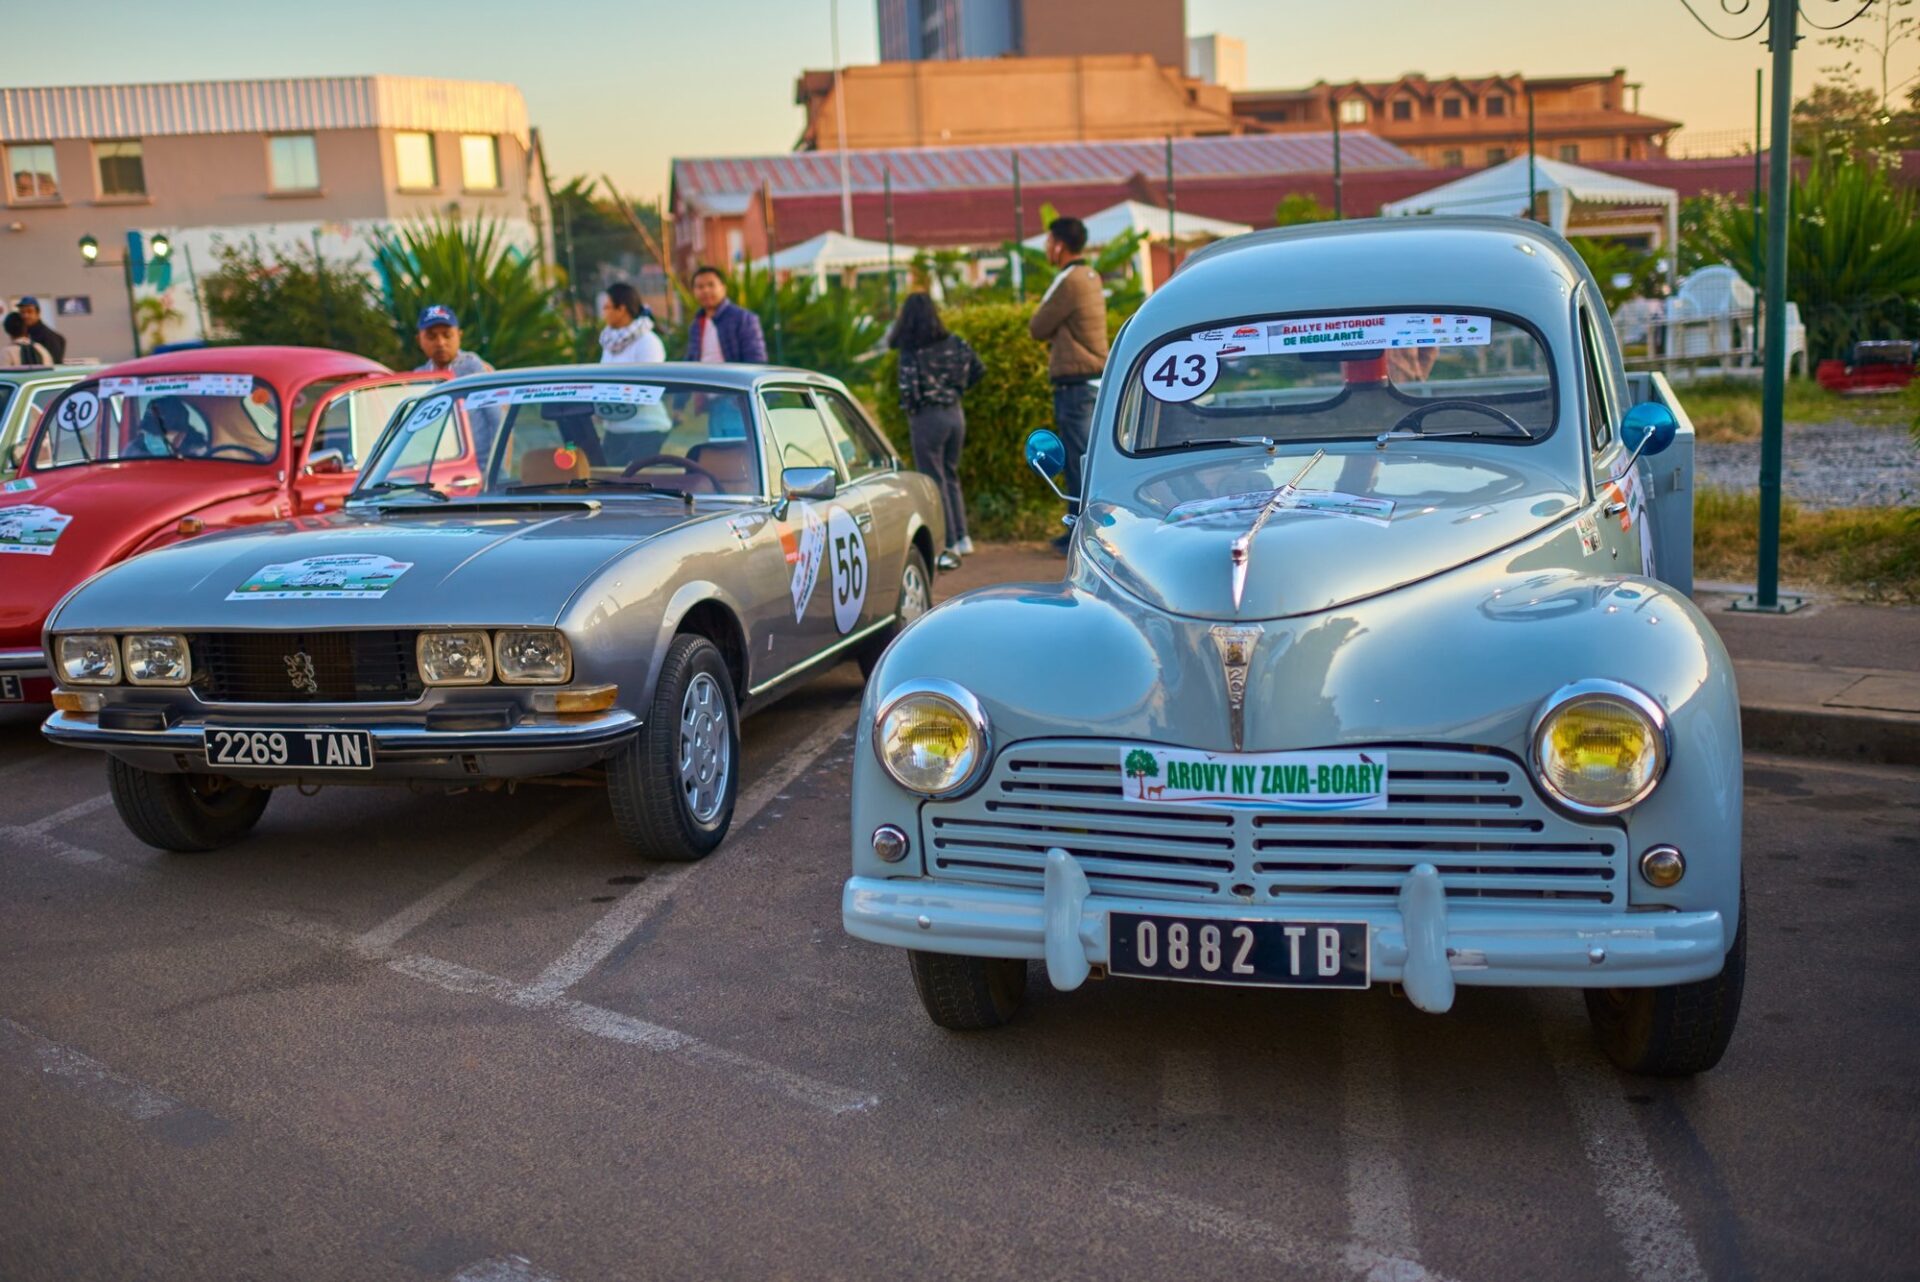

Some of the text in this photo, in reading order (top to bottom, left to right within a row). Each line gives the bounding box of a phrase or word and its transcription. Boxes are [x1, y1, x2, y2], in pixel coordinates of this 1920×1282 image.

[1283, 317, 1385, 335] RALLYE HISTORIQUE
[1283, 328, 1364, 346] DE RÉGULARITÉ
[1152, 354, 1207, 387] 43
[63, 401, 92, 421] 80
[413, 401, 447, 424] 56
[835, 532, 863, 606] 56
[215, 731, 362, 765] 2269 TAN
[1167, 761, 1384, 794] AROVY NY ZAVA-BOARY
[1136, 921, 1341, 976] 0882 TB
